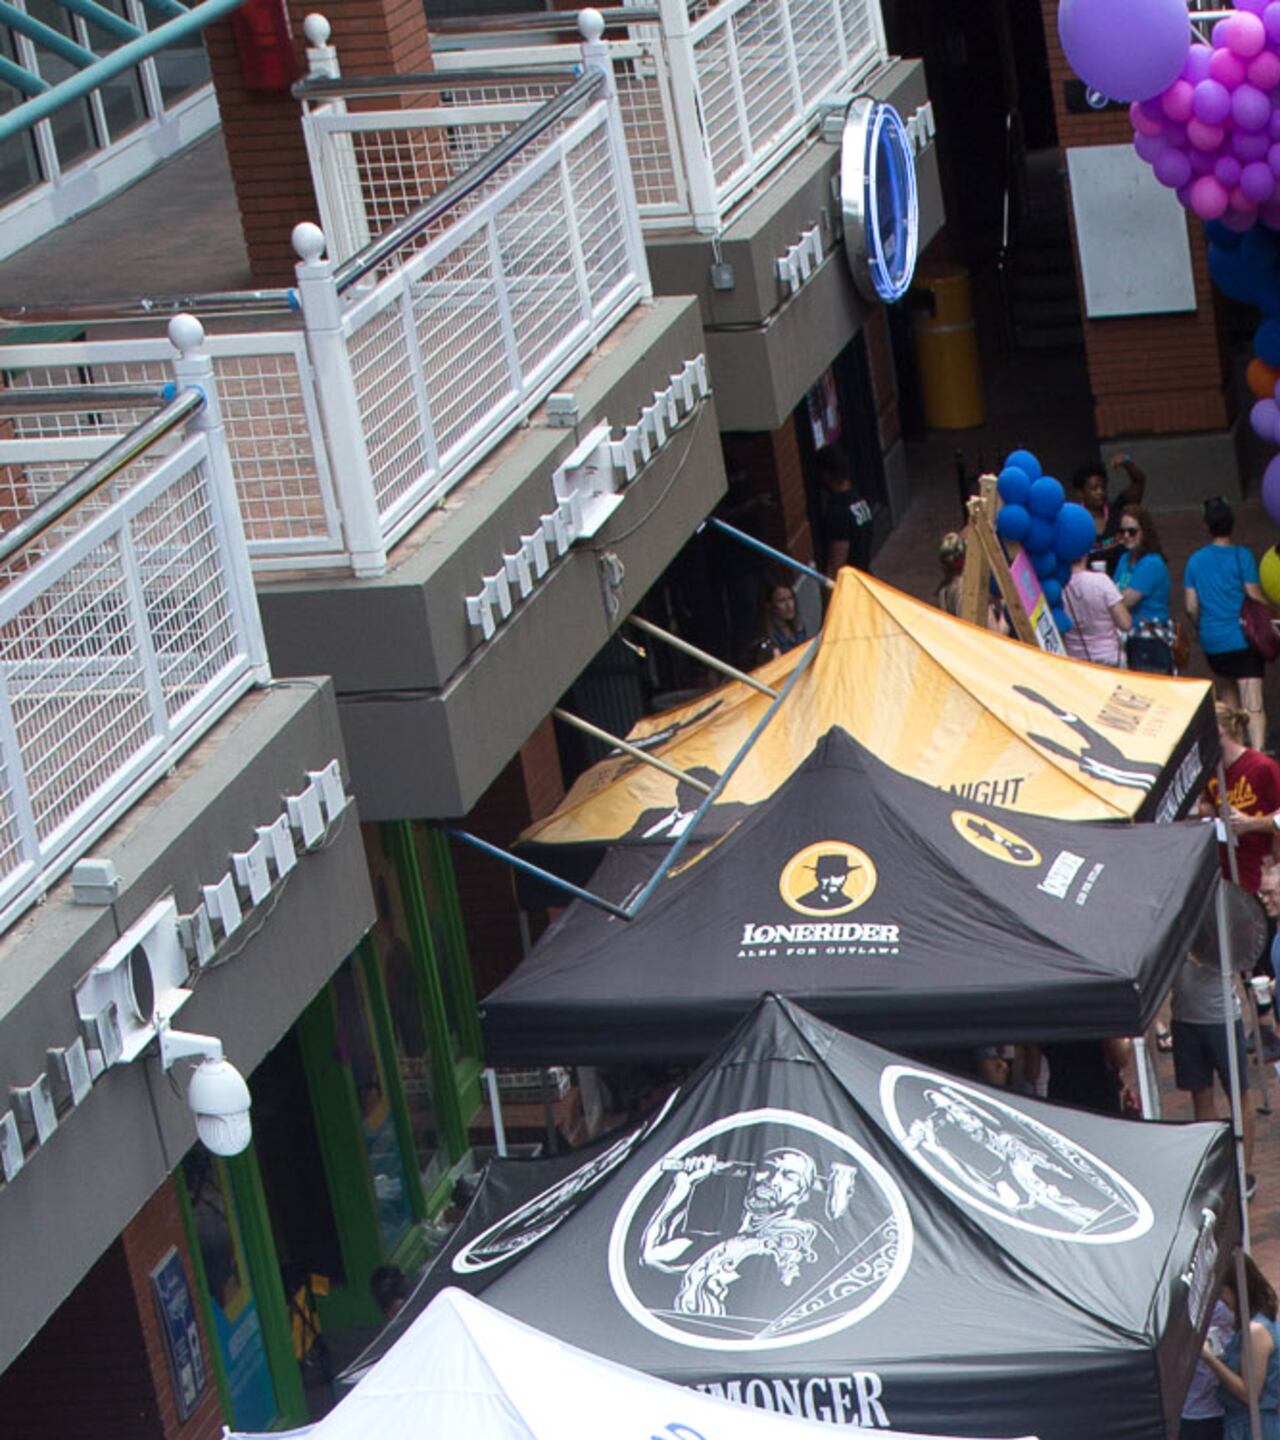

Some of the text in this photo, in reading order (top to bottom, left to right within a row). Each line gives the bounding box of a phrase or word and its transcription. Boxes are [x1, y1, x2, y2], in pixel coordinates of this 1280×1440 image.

[940, 777, 1025, 806] NIGHT
[740, 922, 900, 946] LONERIDER
[737, 946, 900, 958] ALES FOR OUTLAWS
[698, 1371, 891, 1428] MONGER
